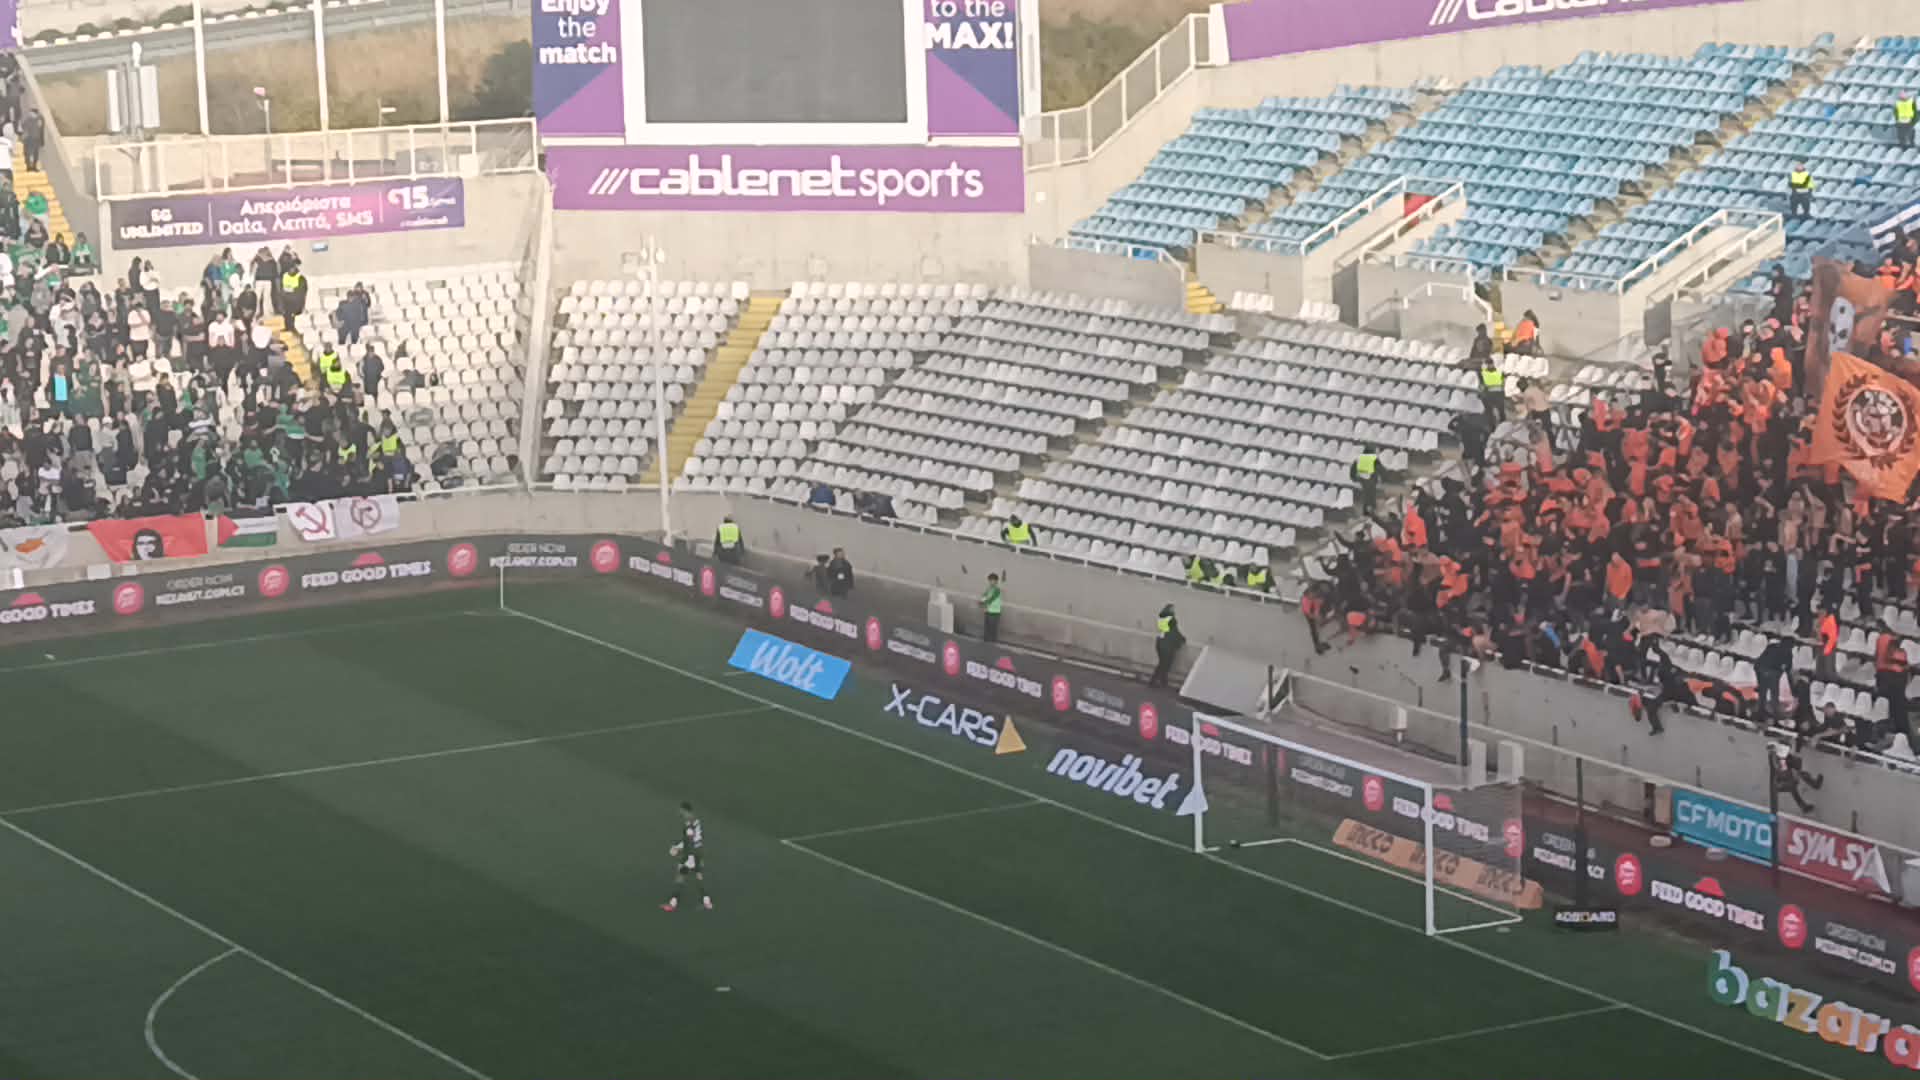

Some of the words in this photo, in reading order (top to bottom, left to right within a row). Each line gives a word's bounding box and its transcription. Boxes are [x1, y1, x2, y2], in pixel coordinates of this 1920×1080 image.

[931, 0, 957, 17] to
[965, 0, 1006, 17] the
[558, 16, 596, 38] the
[925, 21, 1014, 49] MAX!
[539, 42, 617, 64] match
[301, 571, 338, 588] FEED
[341, 565, 386, 584] GOOD
[389, 560, 432, 578] TIMES
[0, 605, 48, 624] GOOD
[51, 600, 96, 618] TIMES
[750, 640, 824, 689] Wolt
[883, 683, 999, 747] X-CARS
[1046, 748, 1180, 809] novibet
[1675, 799, 1773, 848] CFMOTO
[1651, 879, 1684, 905] FEED
[1684, 890, 1725, 918] GOOD
